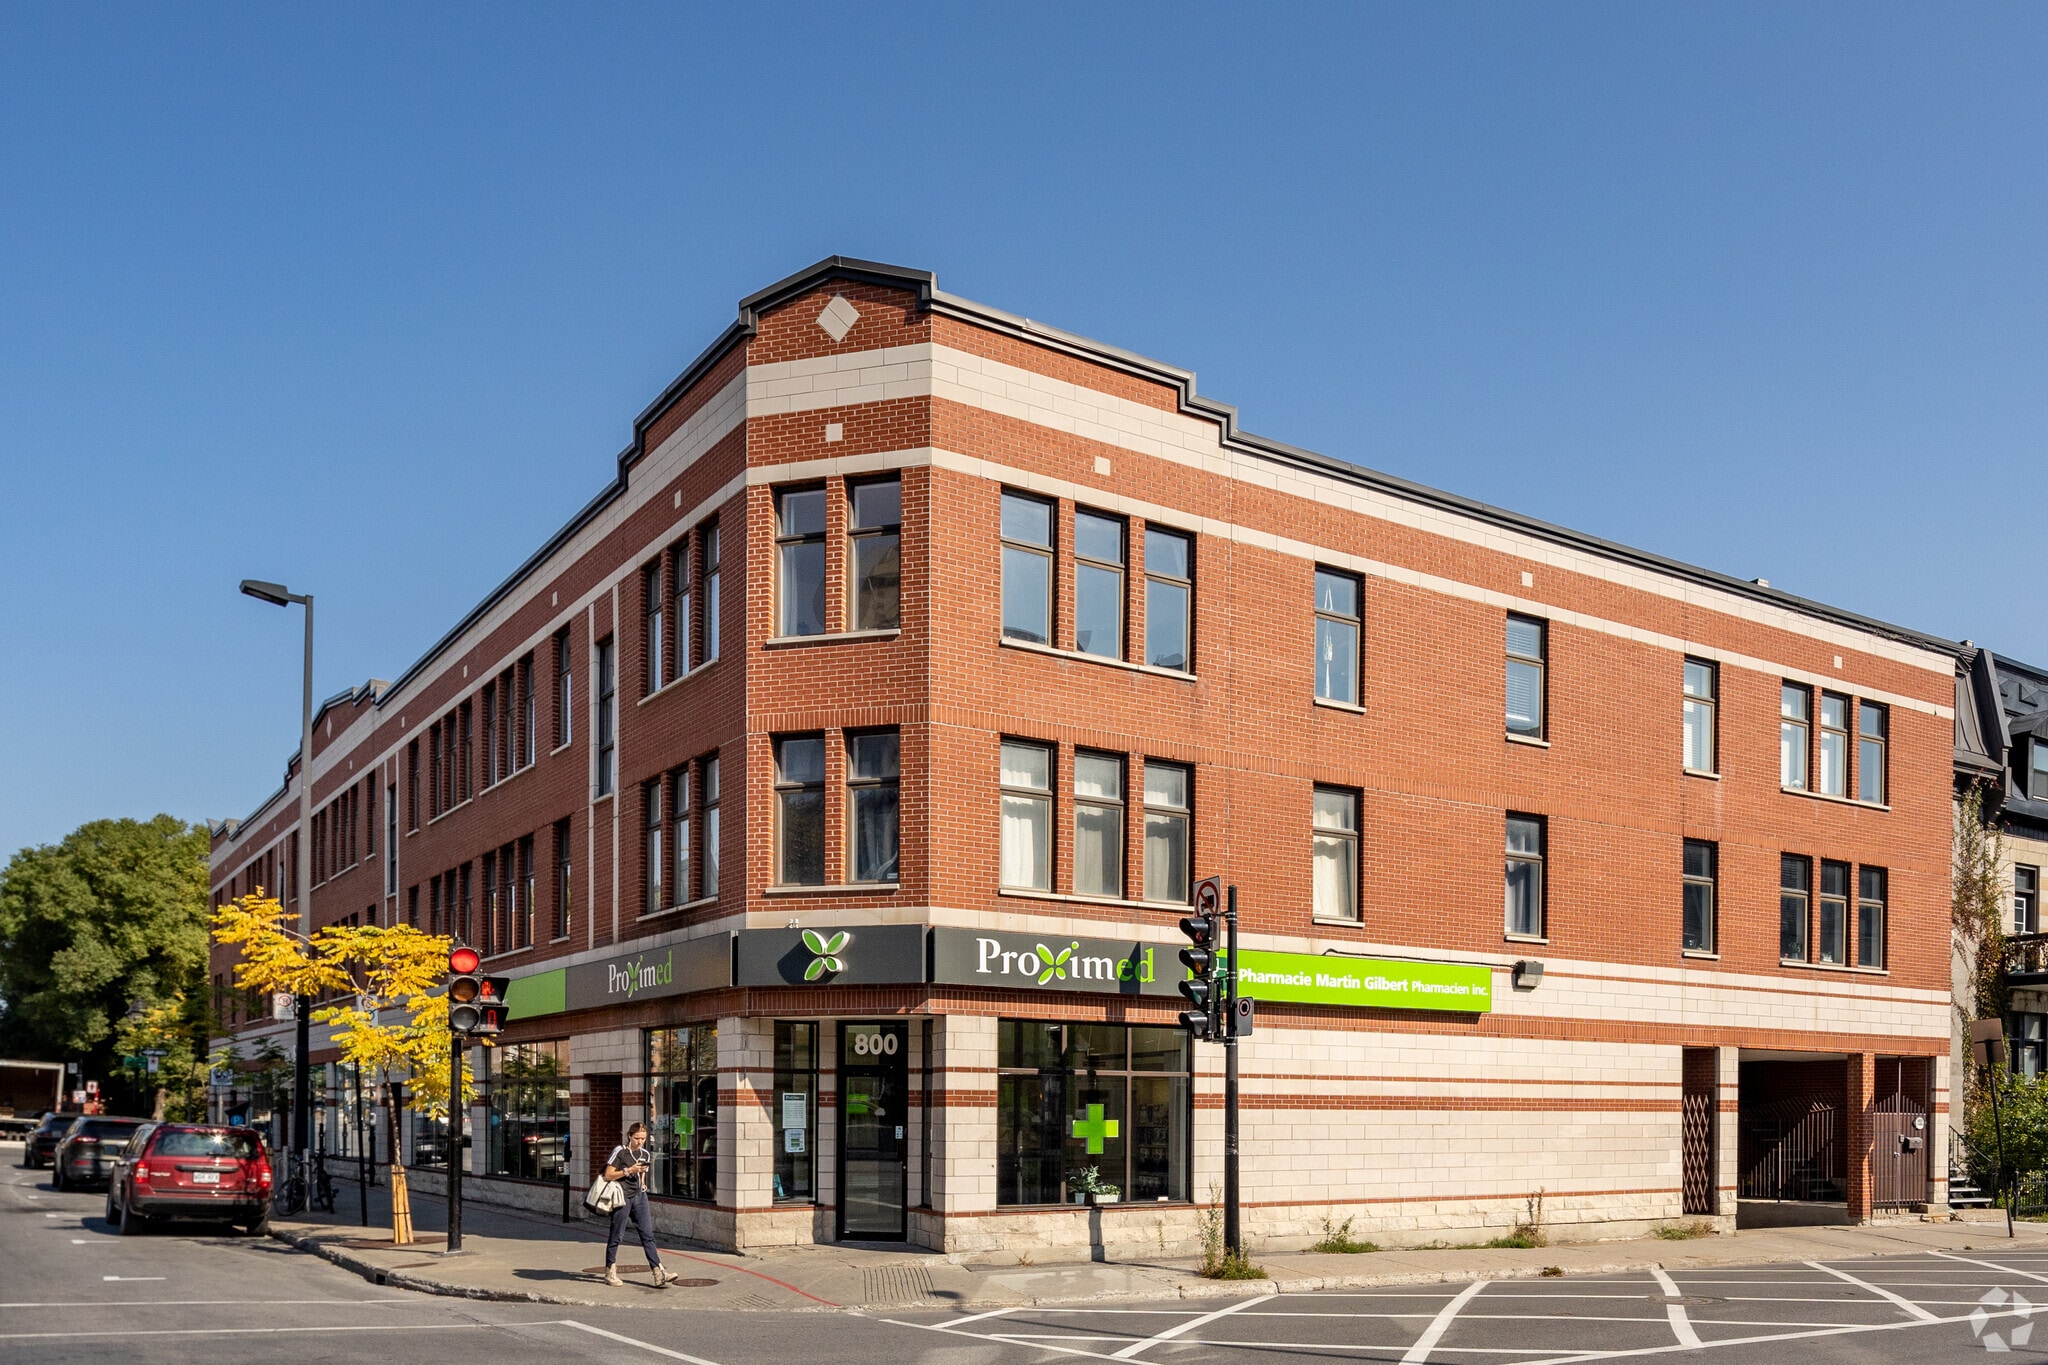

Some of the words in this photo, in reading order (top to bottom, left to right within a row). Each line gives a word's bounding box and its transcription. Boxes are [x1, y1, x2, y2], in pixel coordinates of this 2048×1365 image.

[1239, 967, 1312, 987] Pharmacie
[1316, 973, 1361, 989] Martin
[1364, 975, 1409, 992] Gilbert
[1411, 980, 1469, 995] Pharmacien
[1472, 983, 1489, 996] inc.
[854, 1033, 898, 1055] 800
